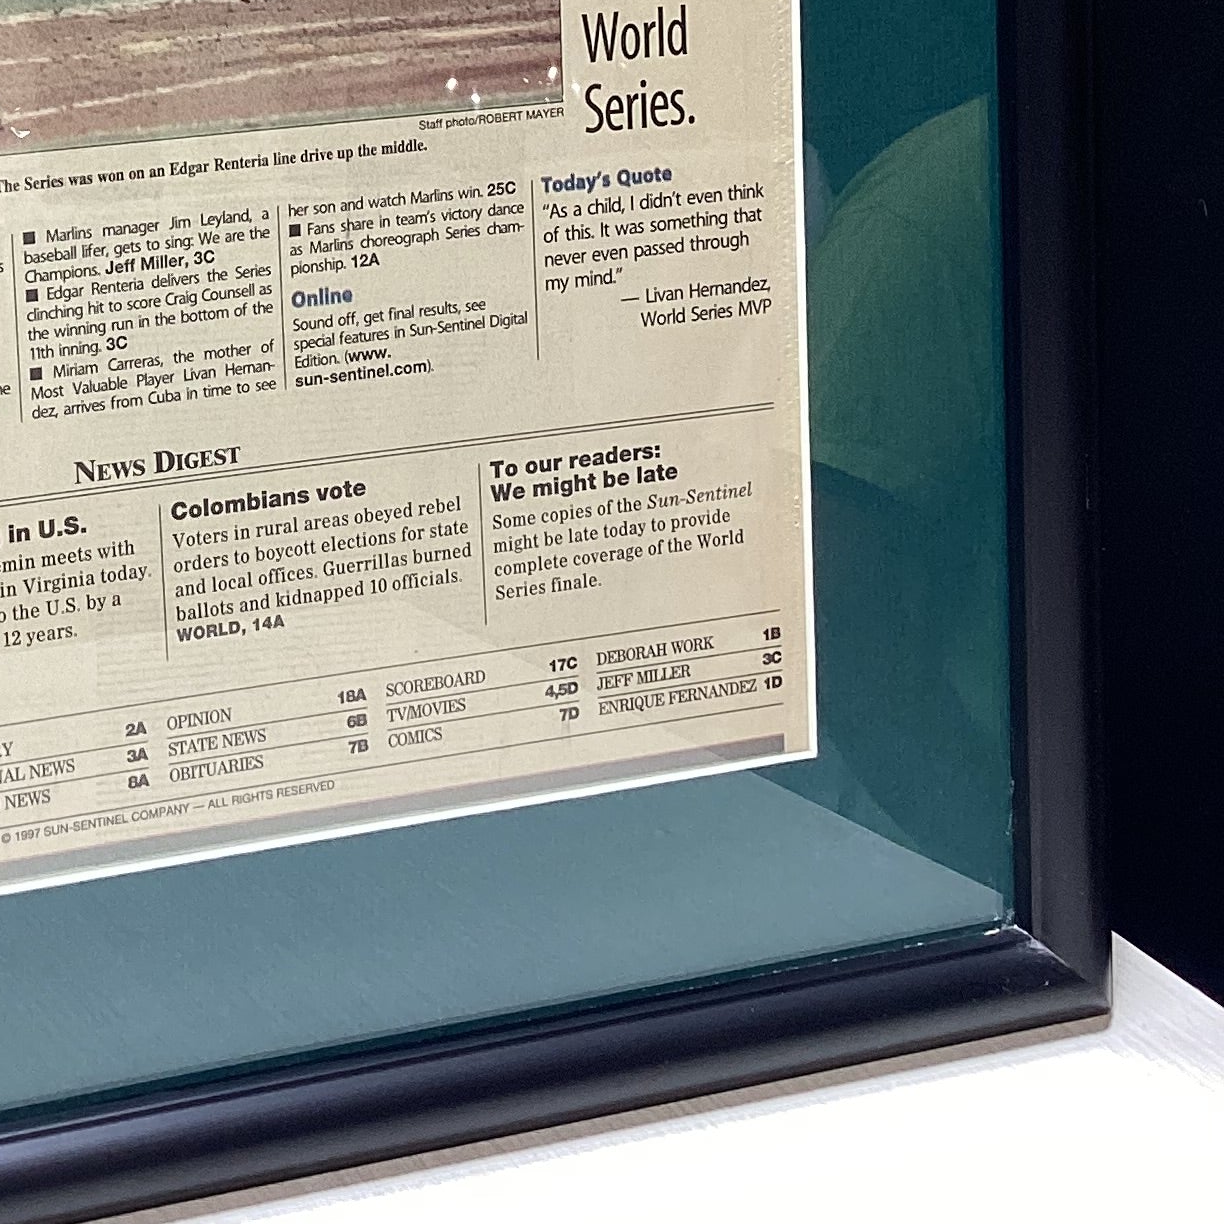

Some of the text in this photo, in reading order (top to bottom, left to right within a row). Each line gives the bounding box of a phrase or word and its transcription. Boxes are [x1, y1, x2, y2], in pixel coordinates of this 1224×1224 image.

[581, 4, 688, 63] World
[419, 118, 443, 131] Staff
[526, 107, 564, 120] MAYER
[585, 80, 695, 134] Series.
[541, 166, 672, 195] Today's Quote
[544, 230, 750, 268] never even passed through
[291, 286, 353, 308] Online
[73, 446, 241, 485] NEWS DIGEST
[489, 445, 661, 479] To our readers:
[171, 480, 366, 521] Colombians vote
[490, 464, 678, 502] We might be late
[172, 495, 461, 549] Voters in rural areas obeyed rebel
[492, 481, 752, 530] Some copies of the Sun-Sentinel
[8, 524, 31, 544] in
[38, 516, 87, 539] U.S.
[41, 547, 92, 568] meets
[97, 540, 135, 559] with
[176, 614, 285, 643] WORLD, 14A
[596, 626, 781, 666] DEBORAH WORK 1B
[386, 656, 578, 697] SCOREBOARD 17C
[596, 650, 782, 691] JEFF MILLER 3C
[166, 688, 367, 731] OPINION 18A
[598, 675, 783, 715] ENRIQUE FERNANDEZ 1D
[125, 721, 147, 737] 2A
[168, 735, 218, 757] STATE
[222, 728, 267, 748] NEWS
[388, 706, 580, 748] COMICS 7D
[29, 758, 75, 780] NEWS
[126, 747, 148, 763] 3A
[169, 739, 369, 783] OBITUARIES 7B
[4, 788, 51, 810] NEWS
